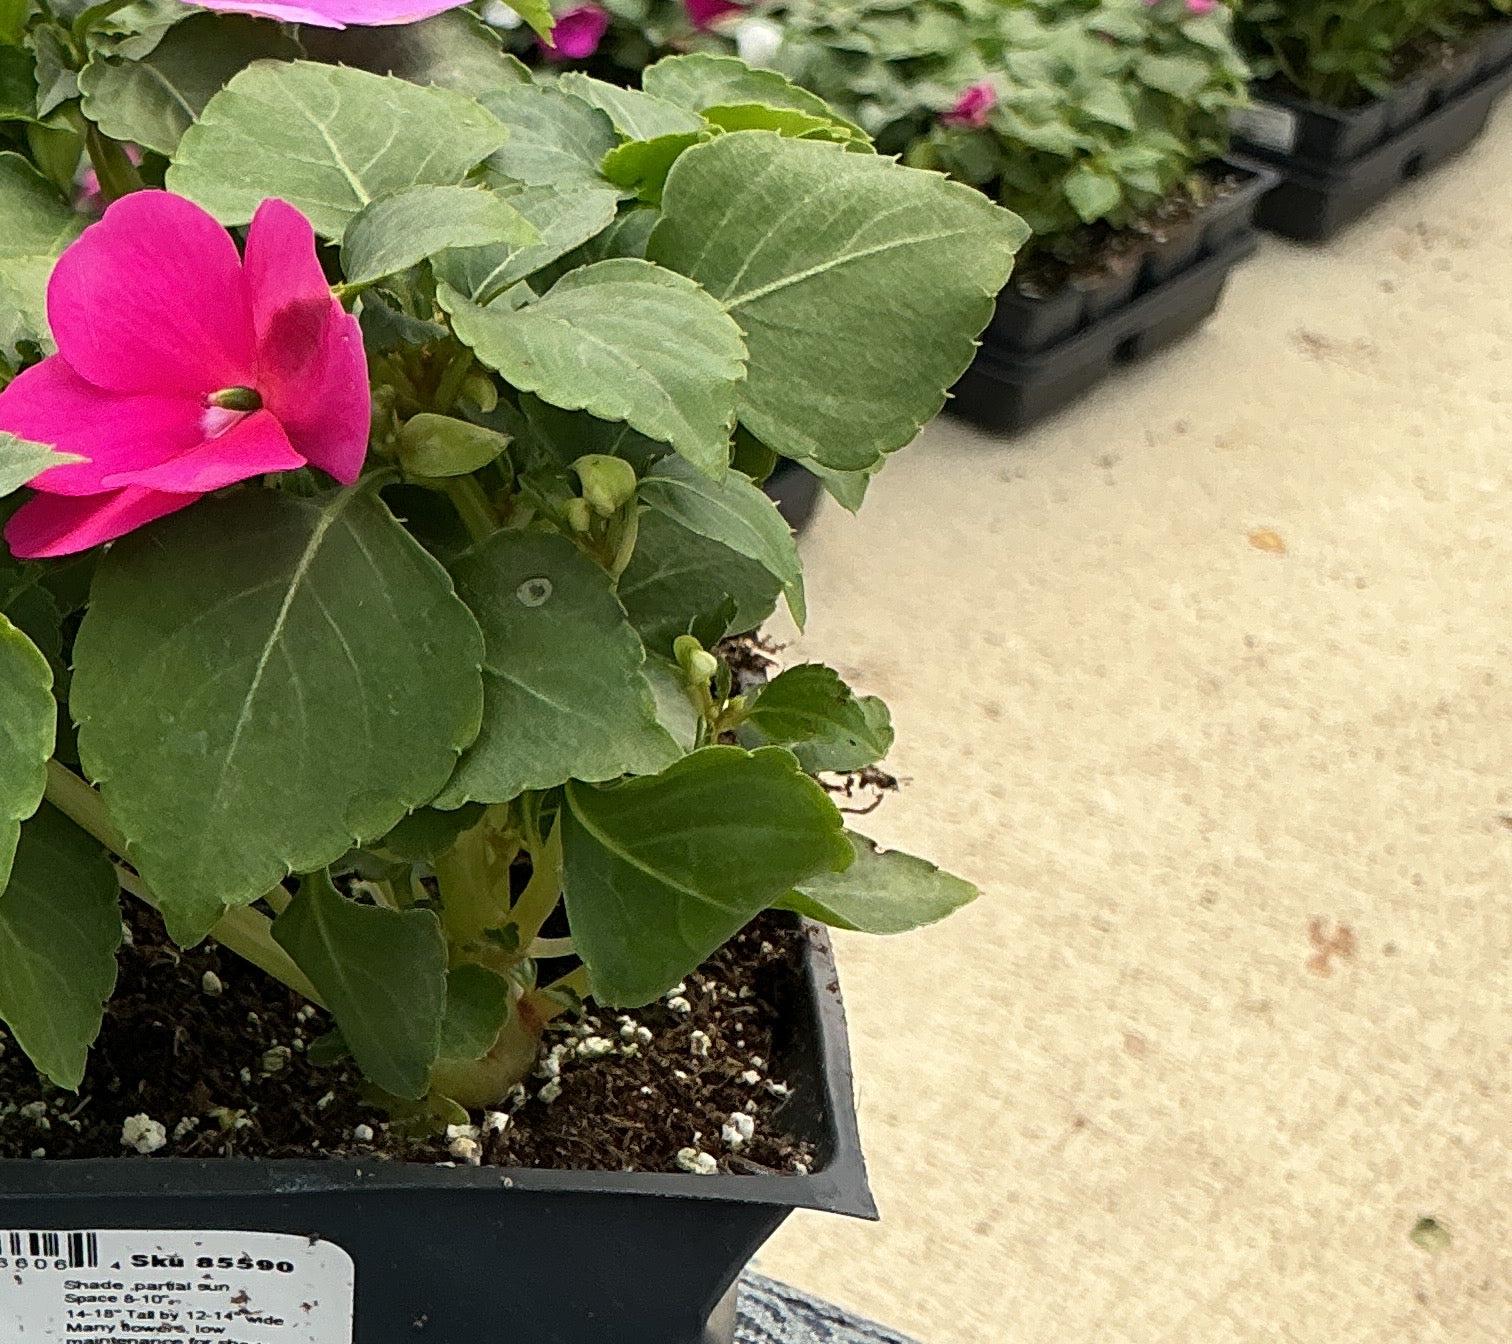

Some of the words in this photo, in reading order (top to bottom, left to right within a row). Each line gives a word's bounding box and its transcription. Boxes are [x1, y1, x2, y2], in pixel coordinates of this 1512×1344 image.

[131, 1254, 184, 1268] Sku
[197, 1256, 294, 1273] 85590
[64, 1280, 124, 1291] Shade
[198, 1283, 229, 1291] sun
[64, 1293, 118, 1305] Space
[127, 1309, 155, 1319] Tall
[160, 1310, 178, 1321] by
[245, 1316, 284, 1326] wide
[66, 1323, 116, 1334] Many
[196, 1325, 226, 1333] low
